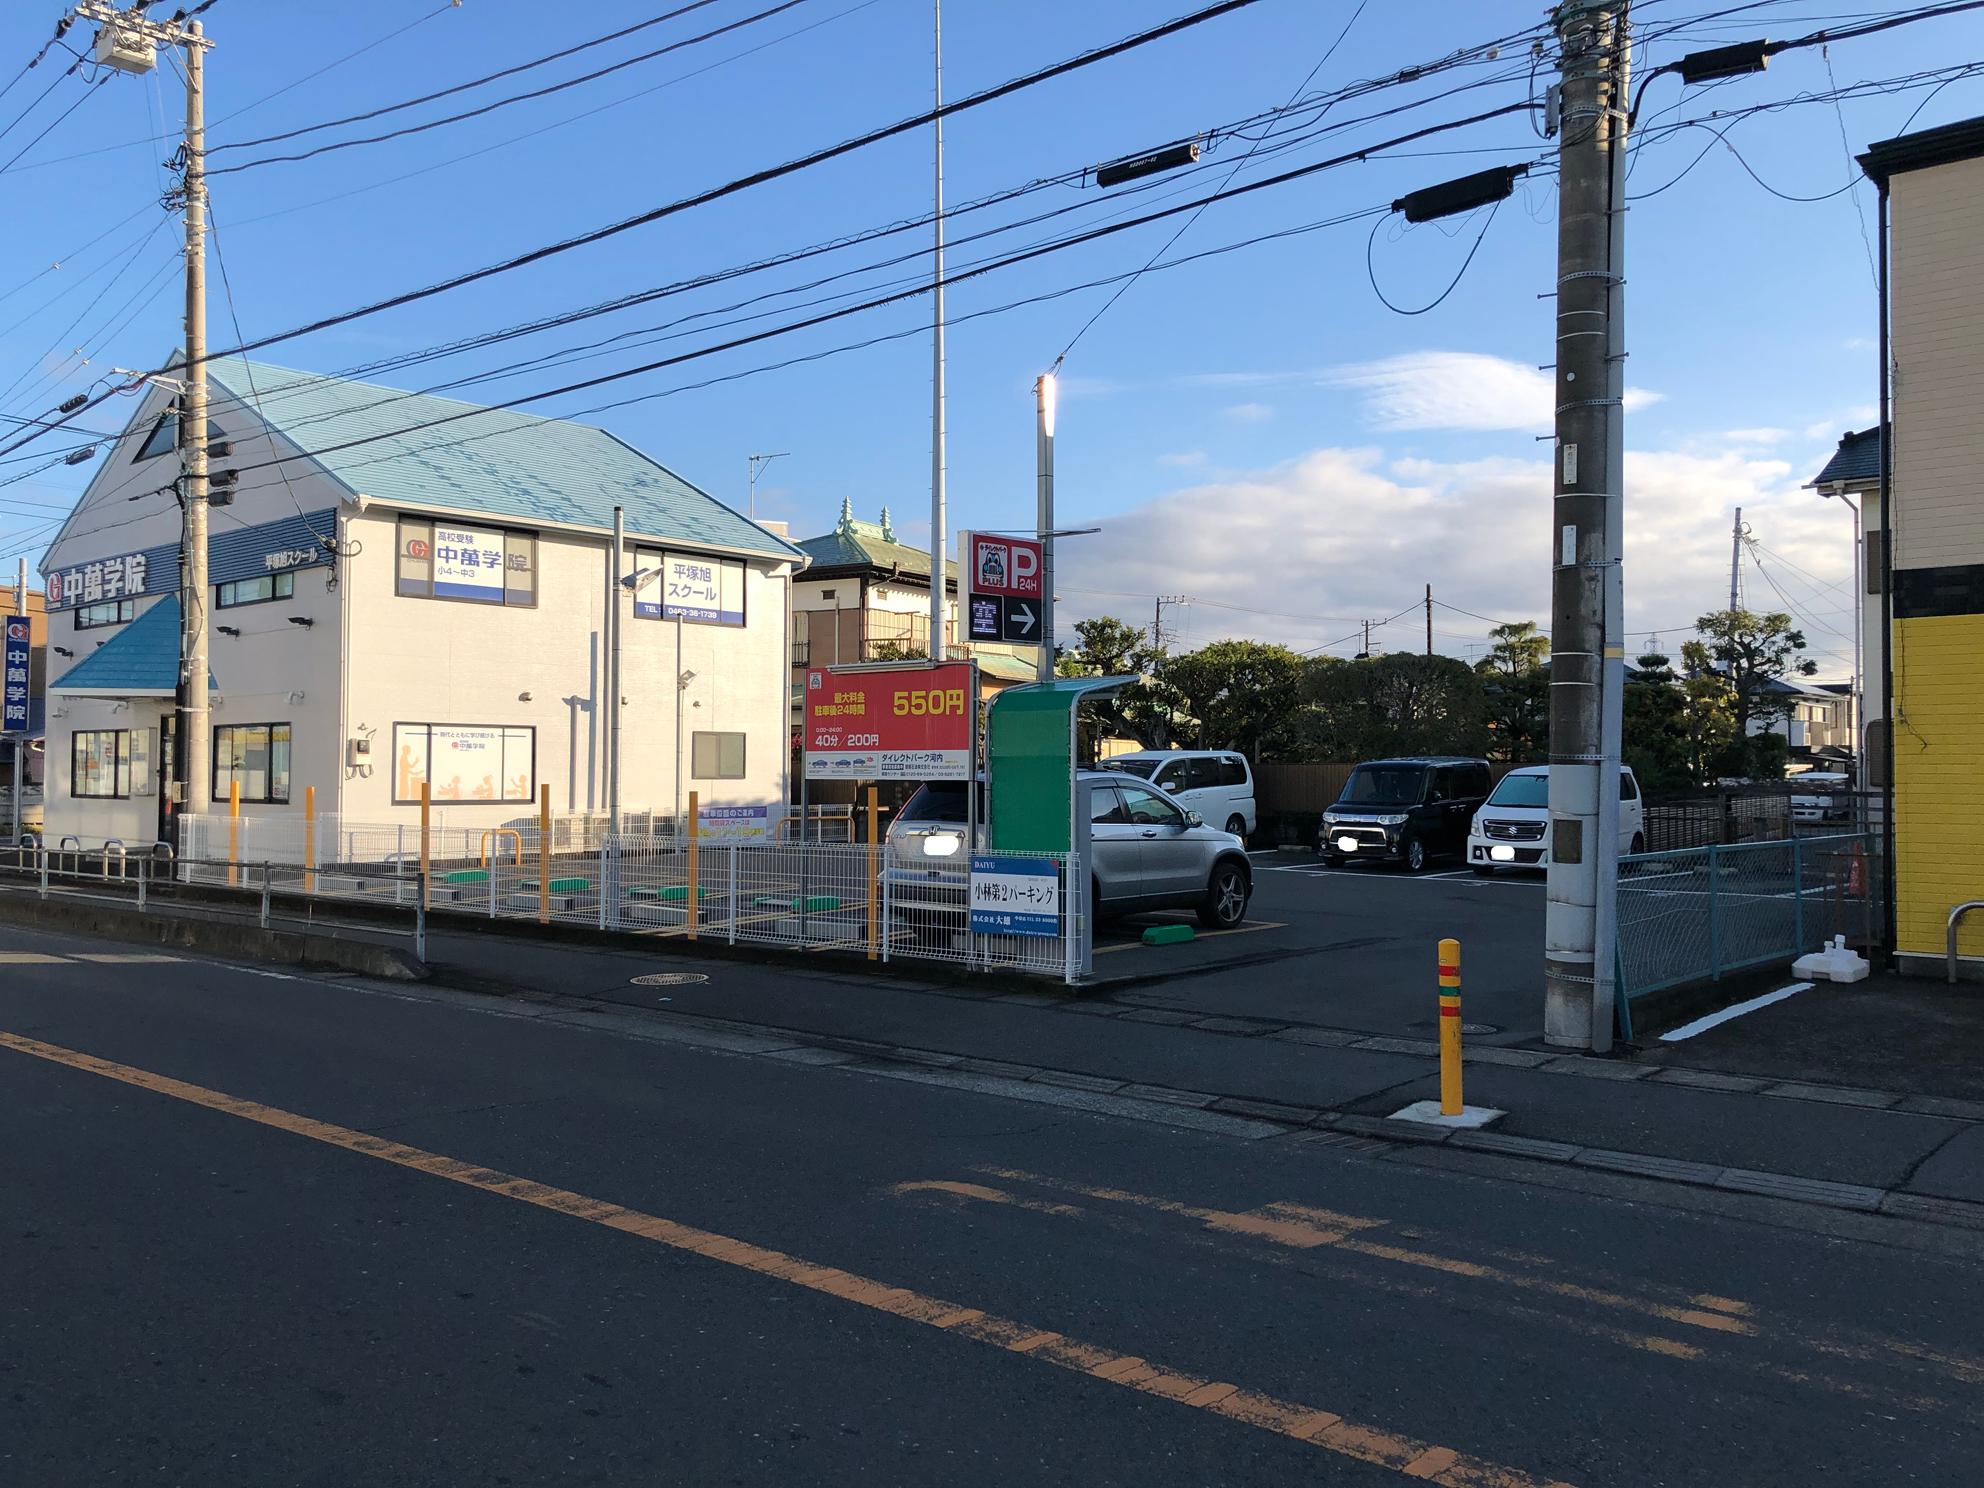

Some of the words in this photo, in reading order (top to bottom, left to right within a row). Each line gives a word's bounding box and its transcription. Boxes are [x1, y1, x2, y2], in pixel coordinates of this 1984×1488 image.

[438, 531, 474, 545] 高校受験
[265, 546, 318, 570] 平塚旭スクール
[437, 545, 528, 572] 中萬学院
[1011, 546, 1037, 589] P
[64, 554, 146, 605] 中萬学院
[673, 563, 712, 583] 平塚旭
[668, 582, 717, 601] スクール
[1019, 578, 1037, 591] 24H
[6, 649, 28, 720] 中萬学院
[834, 691, 865, 704] 最大料金
[893, 688, 965, 717] 550円
[881, 752, 944, 763] ダイレクトパーク河内
[974, 861, 996, 870] DAIYU
[974, 881, 1055, 905] 小林第2パーキング
